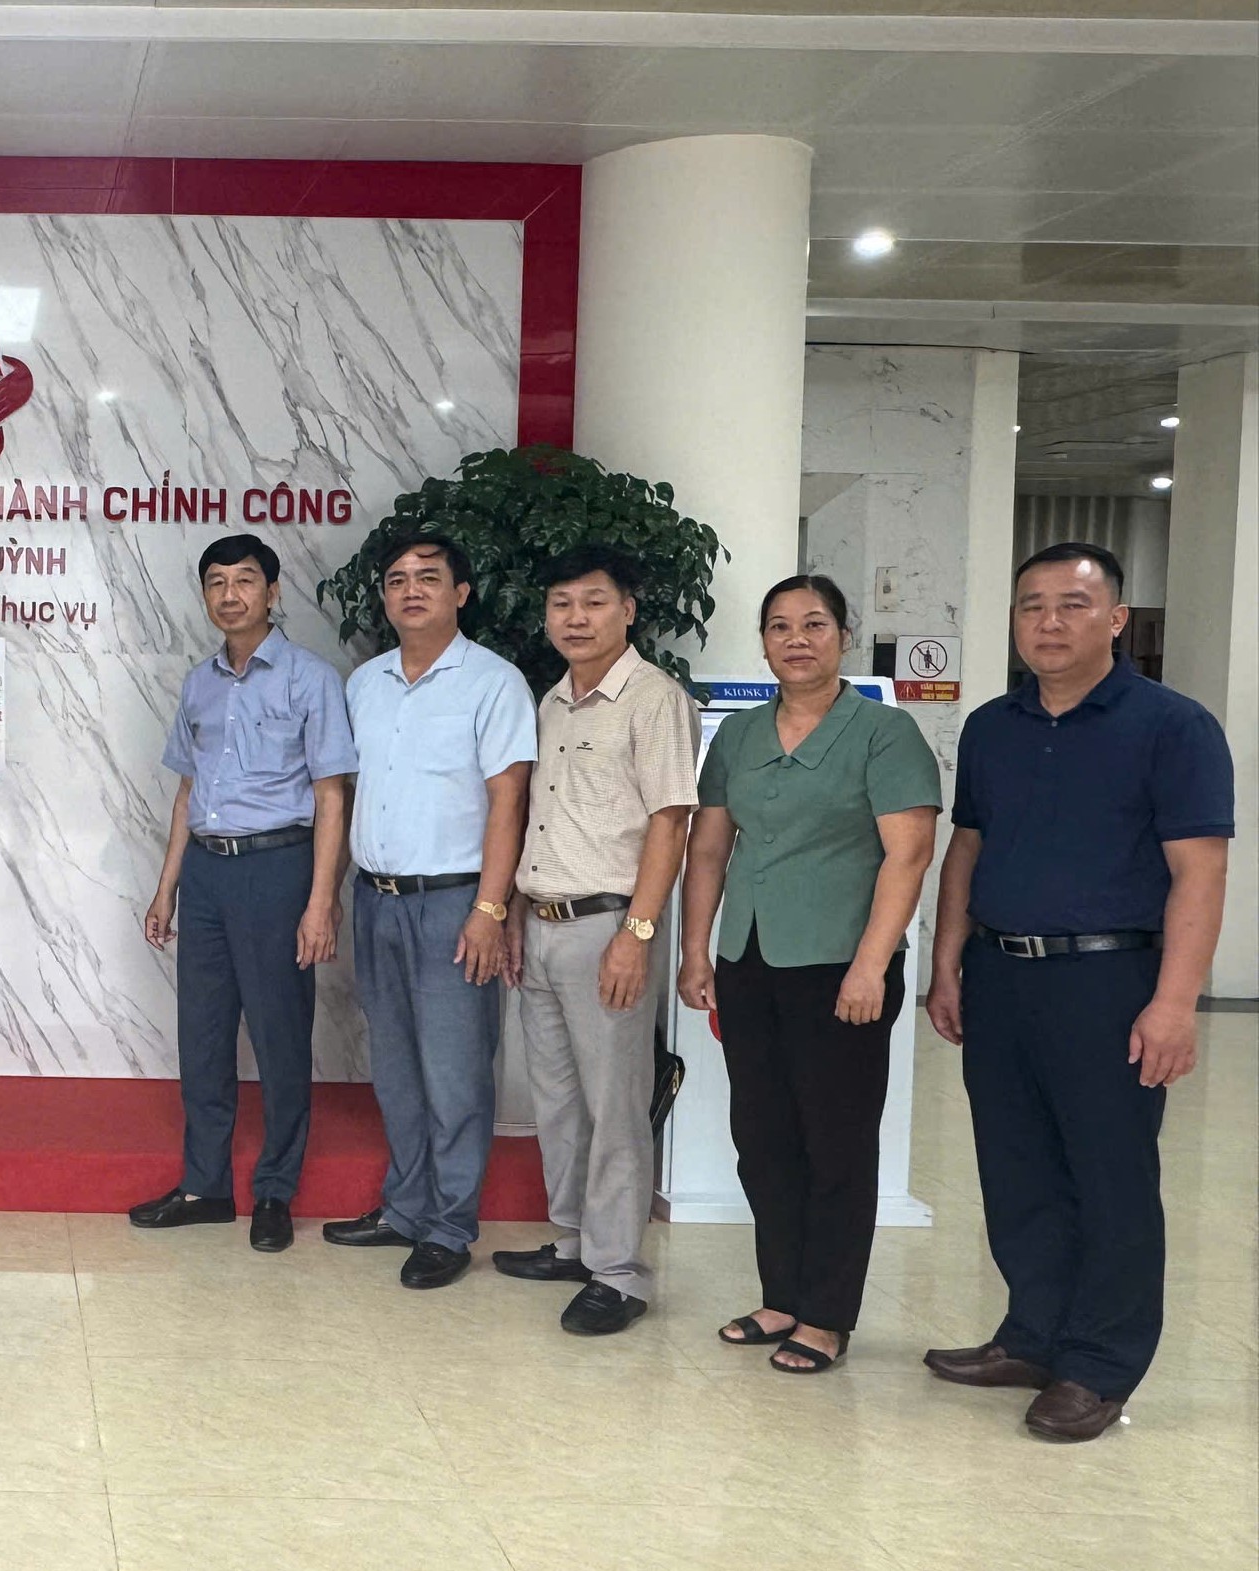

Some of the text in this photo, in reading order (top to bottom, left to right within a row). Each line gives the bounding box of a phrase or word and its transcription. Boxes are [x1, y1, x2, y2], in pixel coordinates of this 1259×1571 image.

[102, 469, 227, 524] CHÍNH
[243, 481, 353, 525] CÔNG
[63, 600, 98, 631] vụ
[723, 687, 762, 698] KIOSK
